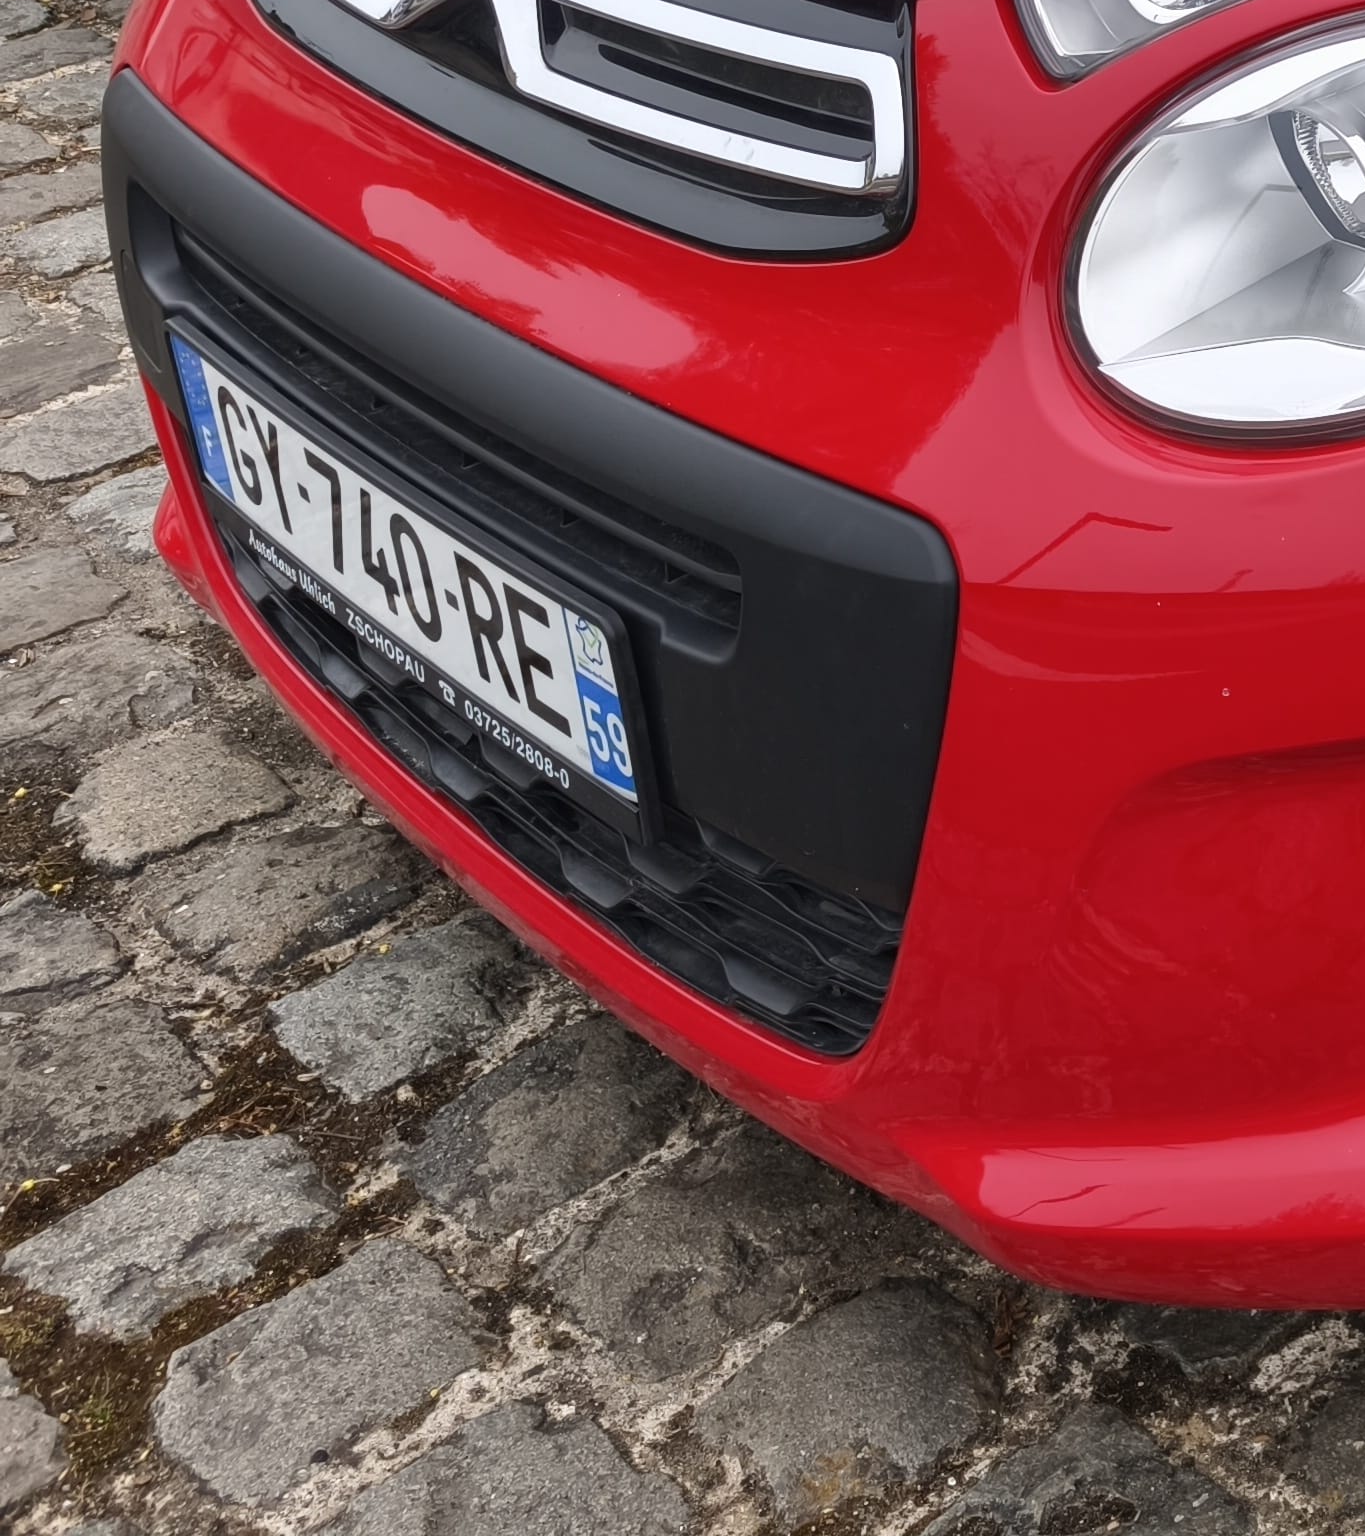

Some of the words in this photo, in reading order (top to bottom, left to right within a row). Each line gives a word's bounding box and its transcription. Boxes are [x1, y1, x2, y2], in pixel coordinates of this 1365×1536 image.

[202, 425, 212, 457] F
[218, 385, 572, 738] GY-740-RE
[249, 529, 297, 582] Autohaus
[299, 570, 336, 615] Uhlich
[346, 608, 425, 683] ZSCHOPAU
[464, 699, 570, 790] 03725/2808-0
[583, 695, 633, 778] 59
